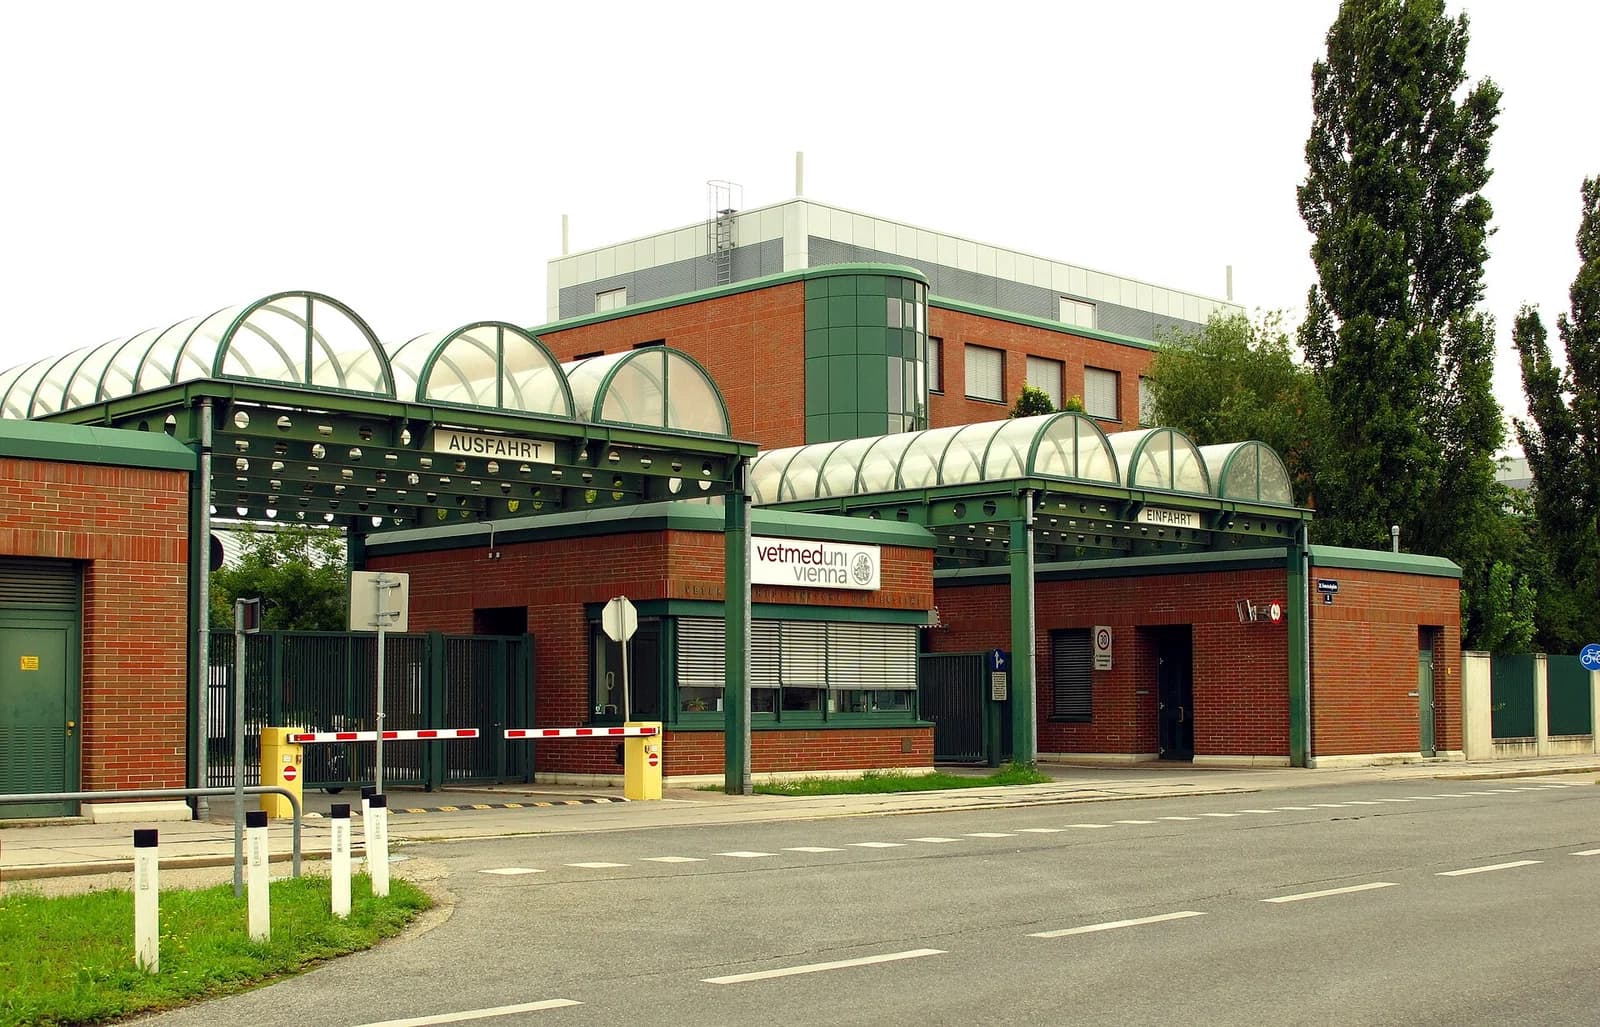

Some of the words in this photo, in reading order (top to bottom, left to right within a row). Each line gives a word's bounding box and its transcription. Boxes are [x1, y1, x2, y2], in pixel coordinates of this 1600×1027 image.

[449, 434, 541, 458] AUSFAHRT
[1147, 509, 1192, 525] EINFAHRT
[757, 543, 847, 567] vetmeduni
[793, 566, 848, 584] vienna
